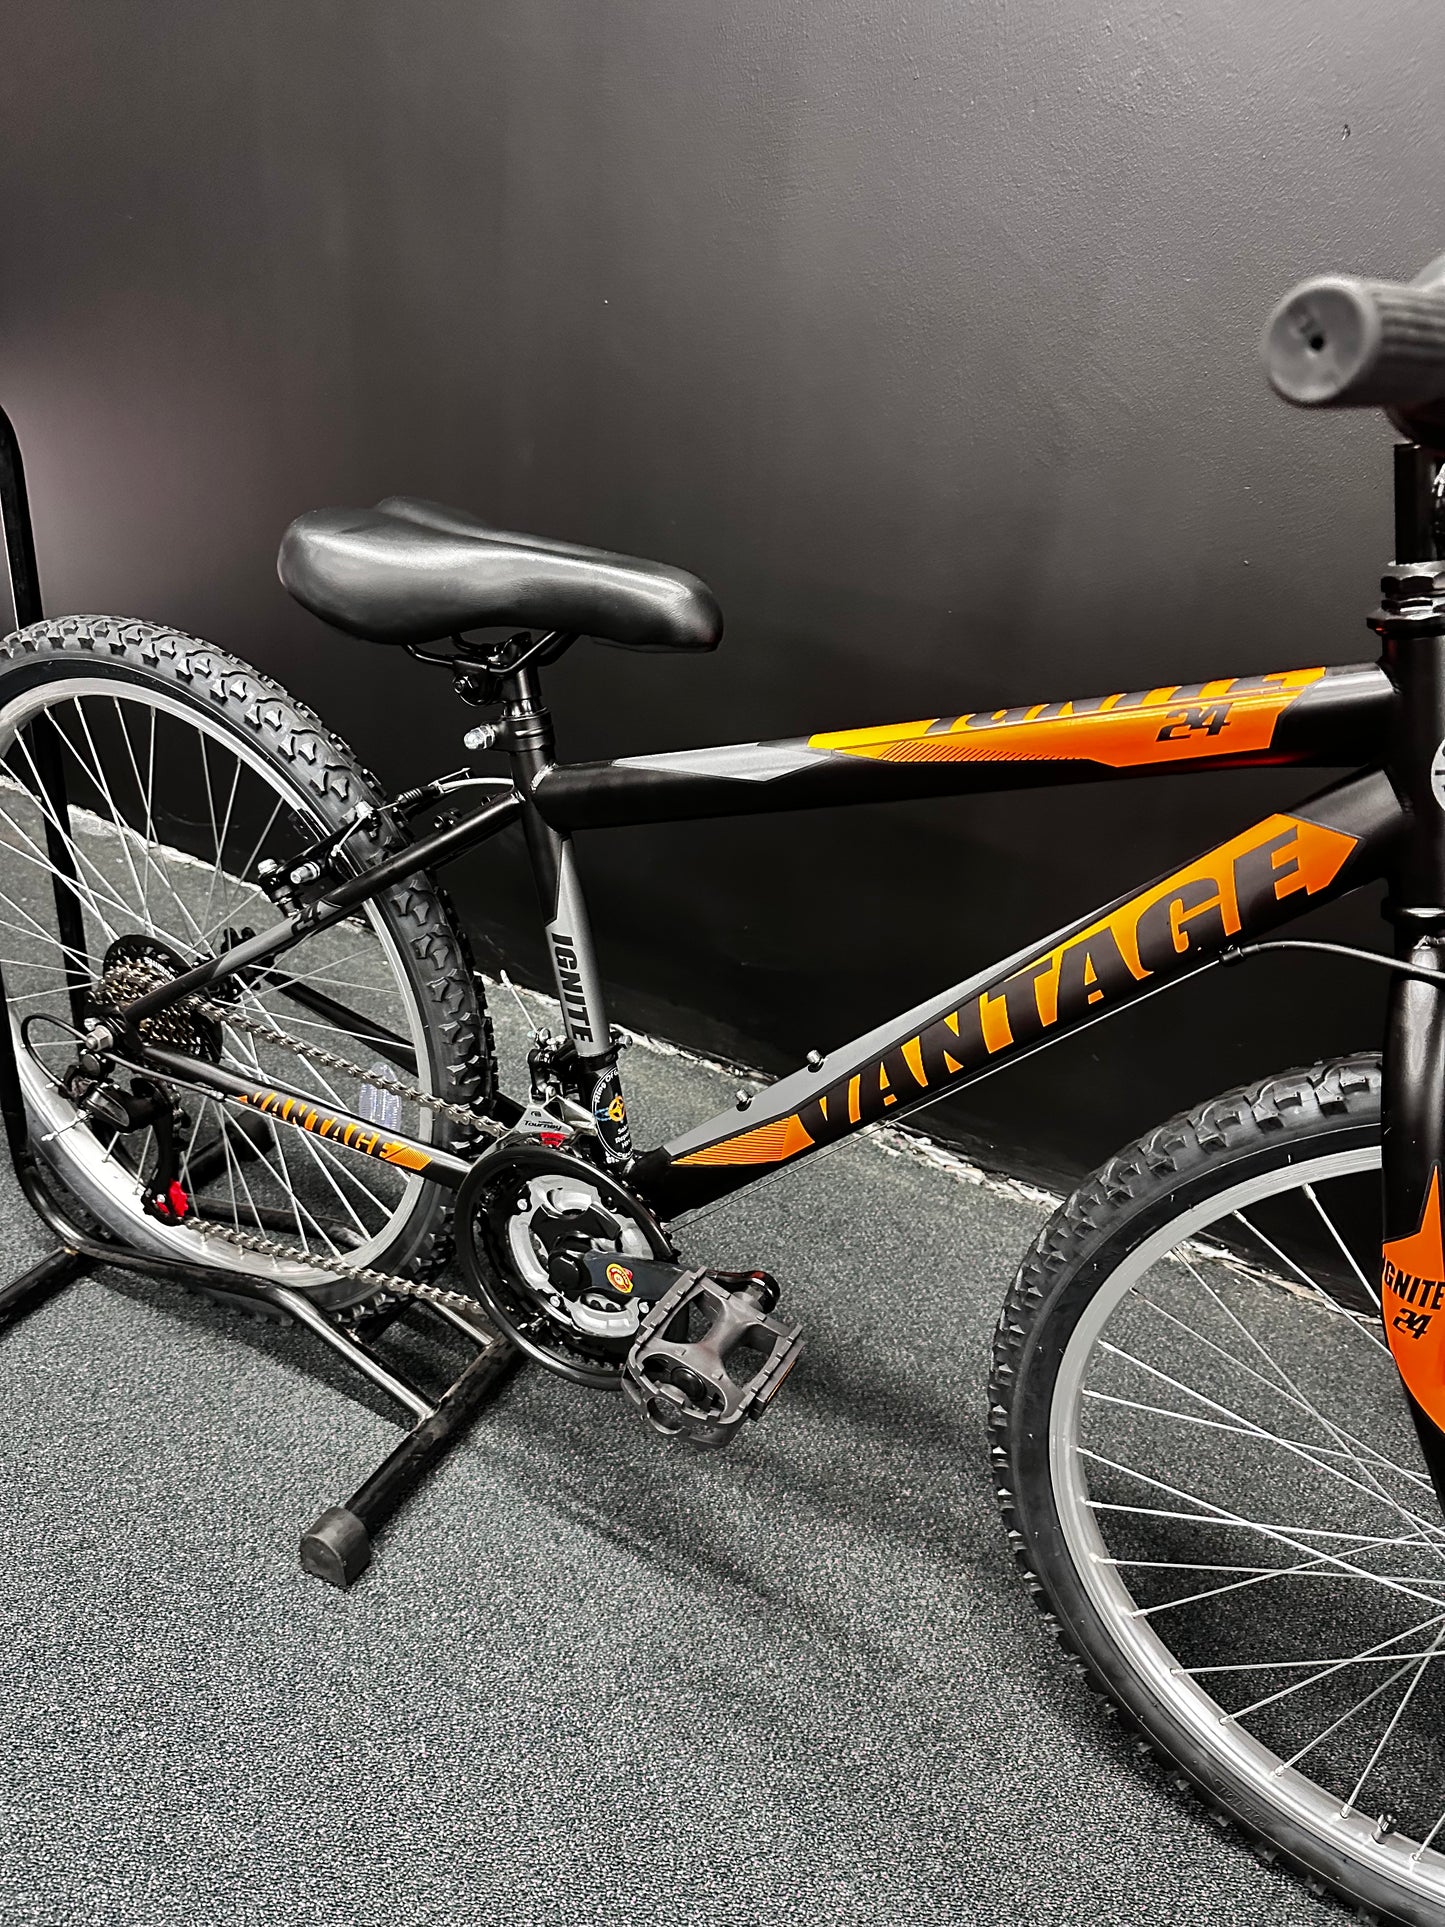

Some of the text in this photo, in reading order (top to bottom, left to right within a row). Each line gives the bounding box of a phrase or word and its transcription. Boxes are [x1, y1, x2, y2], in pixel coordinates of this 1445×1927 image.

[1155, 703, 1232, 742] 24
[551, 932, 594, 1043] IGNITE
[799, 825, 1308, 1142] VANTAGE
[246, 1092, 393, 1160] VANTAGE
[525, 1120, 562, 1132] Tourney
[1384, 1253, 1445, 1310] GNITE
[1392, 1307, 1432, 1340] 24
